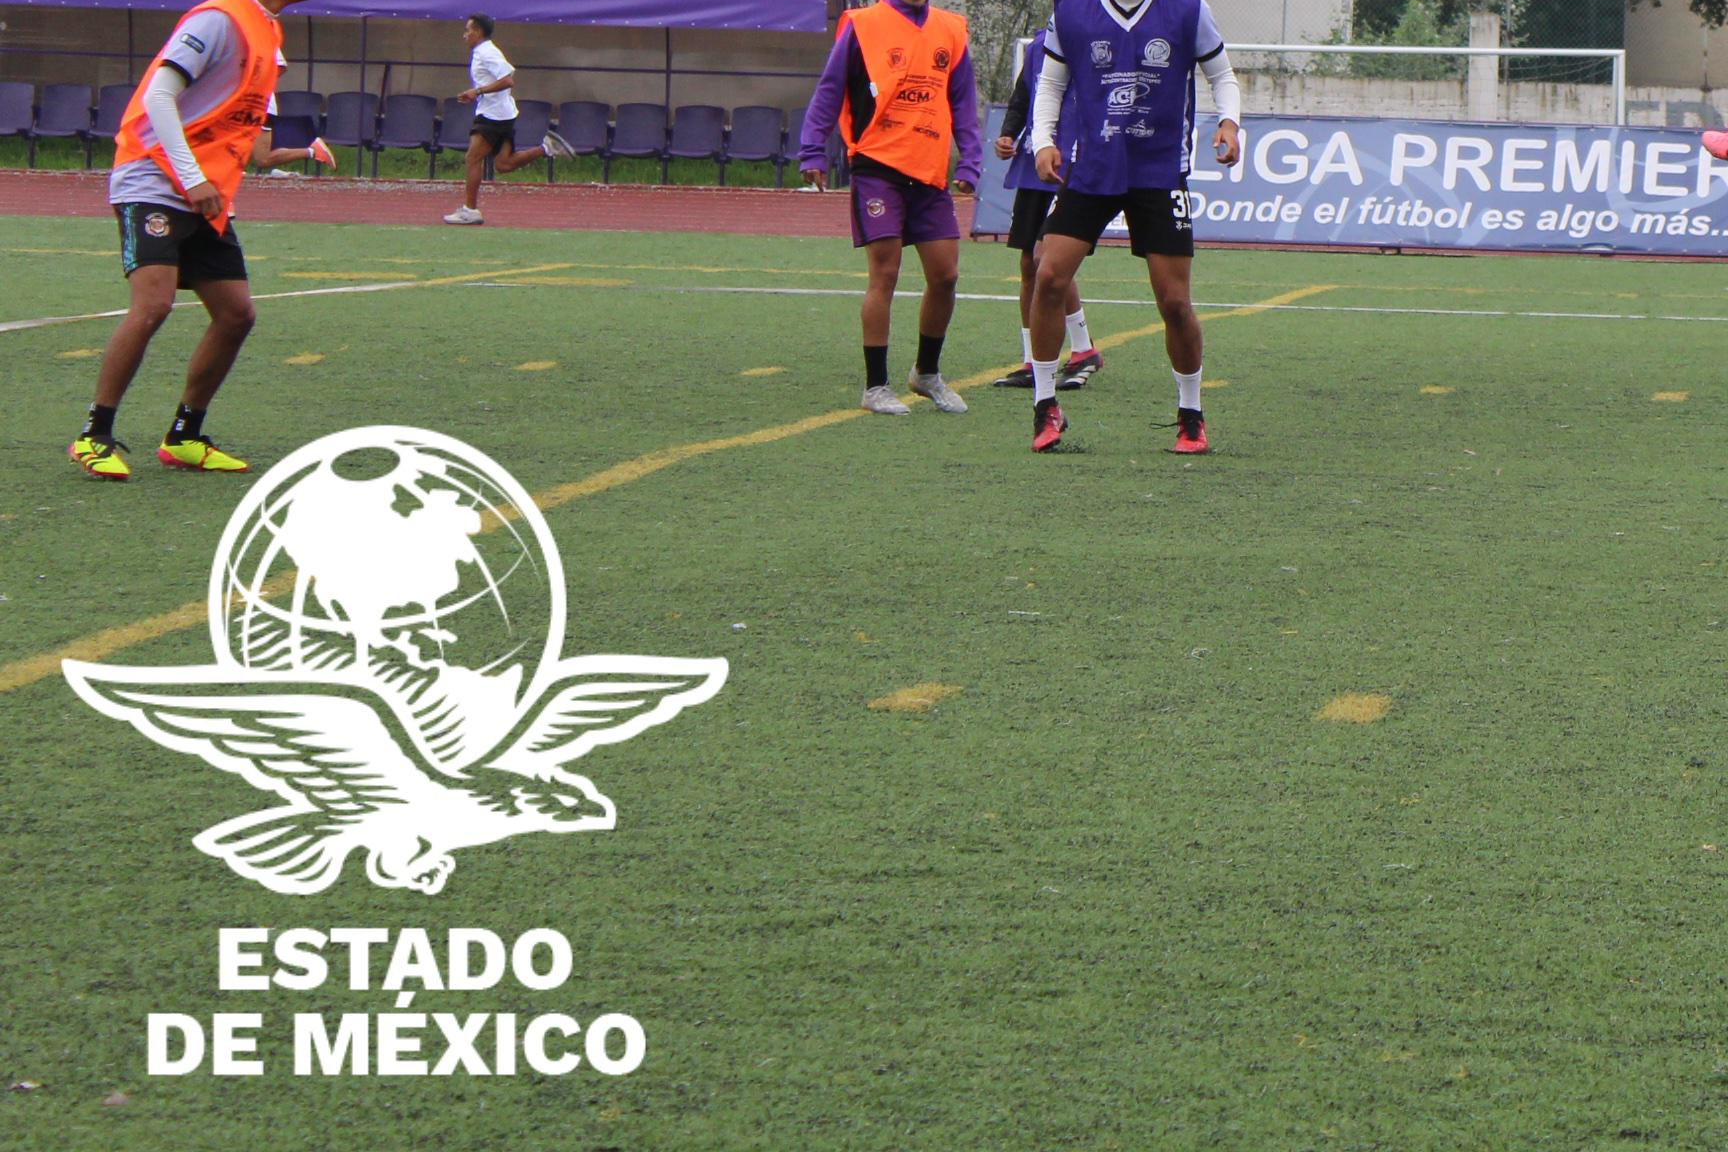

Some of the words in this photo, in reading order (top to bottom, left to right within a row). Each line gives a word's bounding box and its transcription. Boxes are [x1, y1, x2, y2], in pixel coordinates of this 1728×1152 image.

[896, 90, 930, 103] ACM
[1186, 128, 1363, 186] LIGA
[1189, 192, 1302, 223] Donde
[1313, 196, 1344, 225] el
[1359, 193, 1472, 228] fútbol
[1481, 207, 1525, 231] es
[1537, 203, 1620, 238] algo
